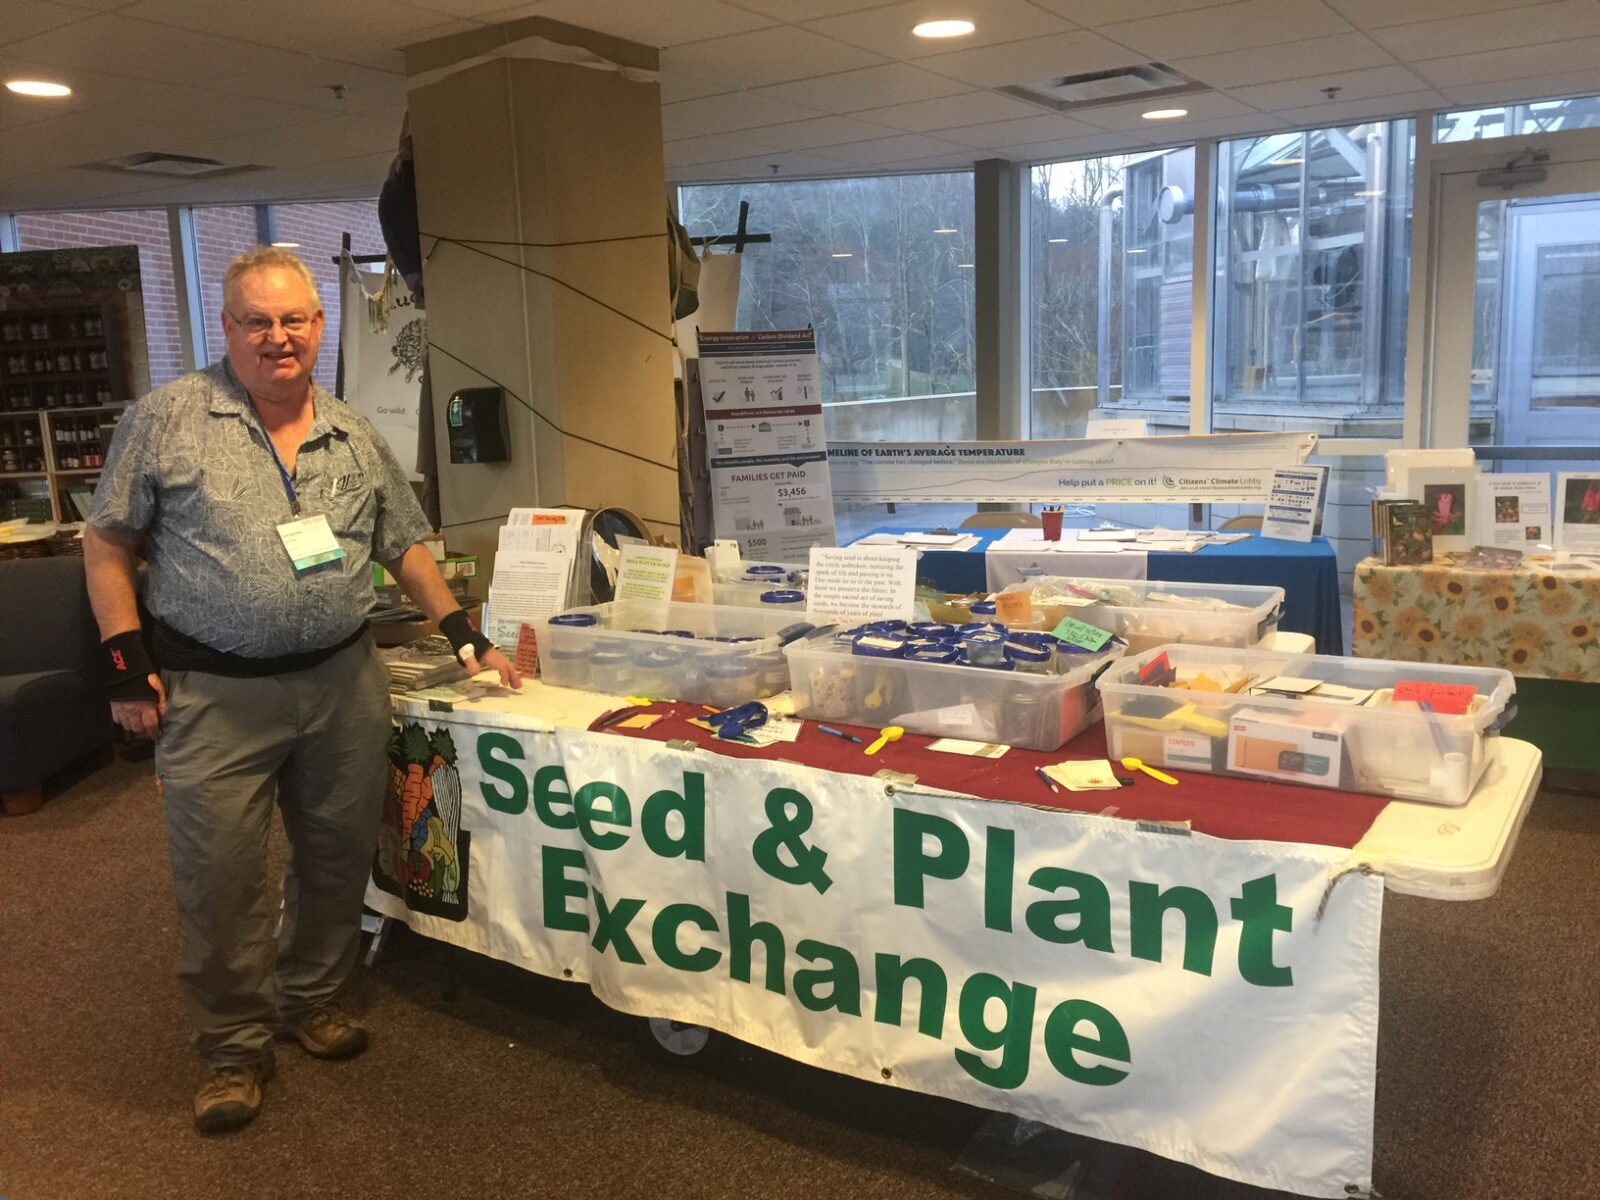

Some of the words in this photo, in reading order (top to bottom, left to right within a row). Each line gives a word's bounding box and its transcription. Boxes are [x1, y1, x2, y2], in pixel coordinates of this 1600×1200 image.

[376, 406, 388, 415] Go
[860, 448, 874, 457] OF
[875, 448, 912, 457] EARTH'S
[914, 448, 956, 457] AVERAGE
[958, 448, 1025, 456] TEMPERATURE
[731, 473, 768, 483] FAMILIES
[770, 472, 786, 481] GET
[787, 470, 806, 480] PAID
[1240, 477, 1262, 486] Lobby
[1058, 478, 1080, 488] Help
[1081, 478, 1096, 488] put
[1106, 478, 1132, 486] PRICE
[1148, 477, 1157, 486] it!
[777, 486, 806, 498] $3,456
[747, 538, 767, 547] $500
[497, 626, 520, 639] See
[478, 732, 705, 862] Seed
[752, 787, 834, 895] &
[894, 808, 1294, 987] Plant
[541, 844, 1132, 1090] Exchange
